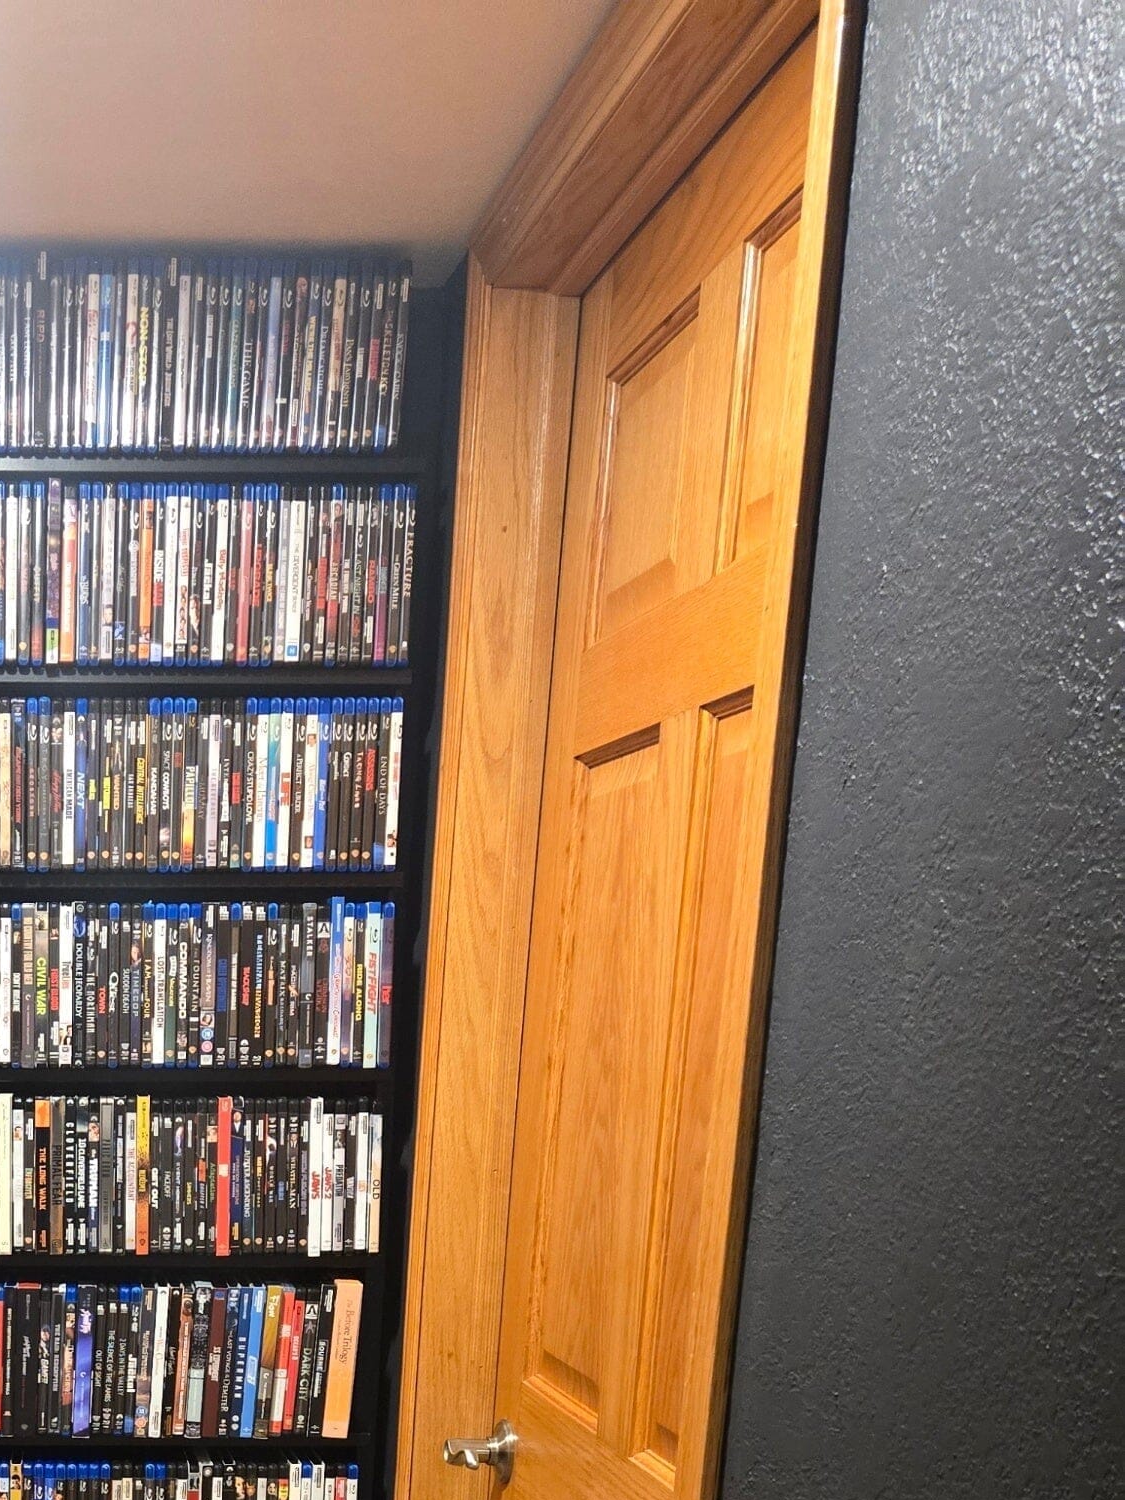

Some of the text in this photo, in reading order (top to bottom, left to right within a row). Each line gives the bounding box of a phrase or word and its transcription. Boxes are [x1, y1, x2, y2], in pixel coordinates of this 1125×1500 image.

[139, 307, 148, 386] NON-STOP
[154, 550, 163, 582] INSIDE
[330, 561, 339, 600] ARCADIAN
[403, 532, 414, 598] FRACTURE
[391, 562, 401, 610] GREEN MILE
[77, 772, 85, 810] NEXT
[378, 756, 388, 815] END OF DAYS
[306, 916, 314, 957] STALKER
[37, 957, 46, 1016] CIVIL WAR
[75, 943, 83, 1018] DOUBLE JEOPARDY
[98, 986, 106, 1014] TOWN
[122, 968, 130, 993] SUDDEN
[178, 942, 188, 1019] COMMANDO
[382, 986, 392, 1005] her
[86, 973, 95, 1033] THE NORTHMAN
[156, 979, 164, 1028] TRANSLATION
[355, 988, 363, 1021] ALONG
[52, 1144, 62, 1206] PRIMAL FEAR
[65, 1122, 74, 1204] CLOVERFIELD
[89, 1158, 98, 1207] TRUMAN
[127, 1162, 135, 1201] ACCOUNTANT
[324, 1167, 332, 1192] JAWS
[335, 1164, 344, 1197] PREDATOR
[151, 1168, 159, 1209] GET OUT
[163, 1171, 171, 1199] FACE/OFF
[311, 1171, 320, 1200] JAWS
[372, 1179, 380, 1200] OLD
[343, 1309, 355, 1336] Before
[95, 1350, 103, 1362] OUT
[95, 1363, 102, 1371] OF
[234, 1337, 246, 1399] SUPERMAN
[339, 1336, 353, 1365] Trilogy
[298, 1347, 312, 1401] DARK CITY
